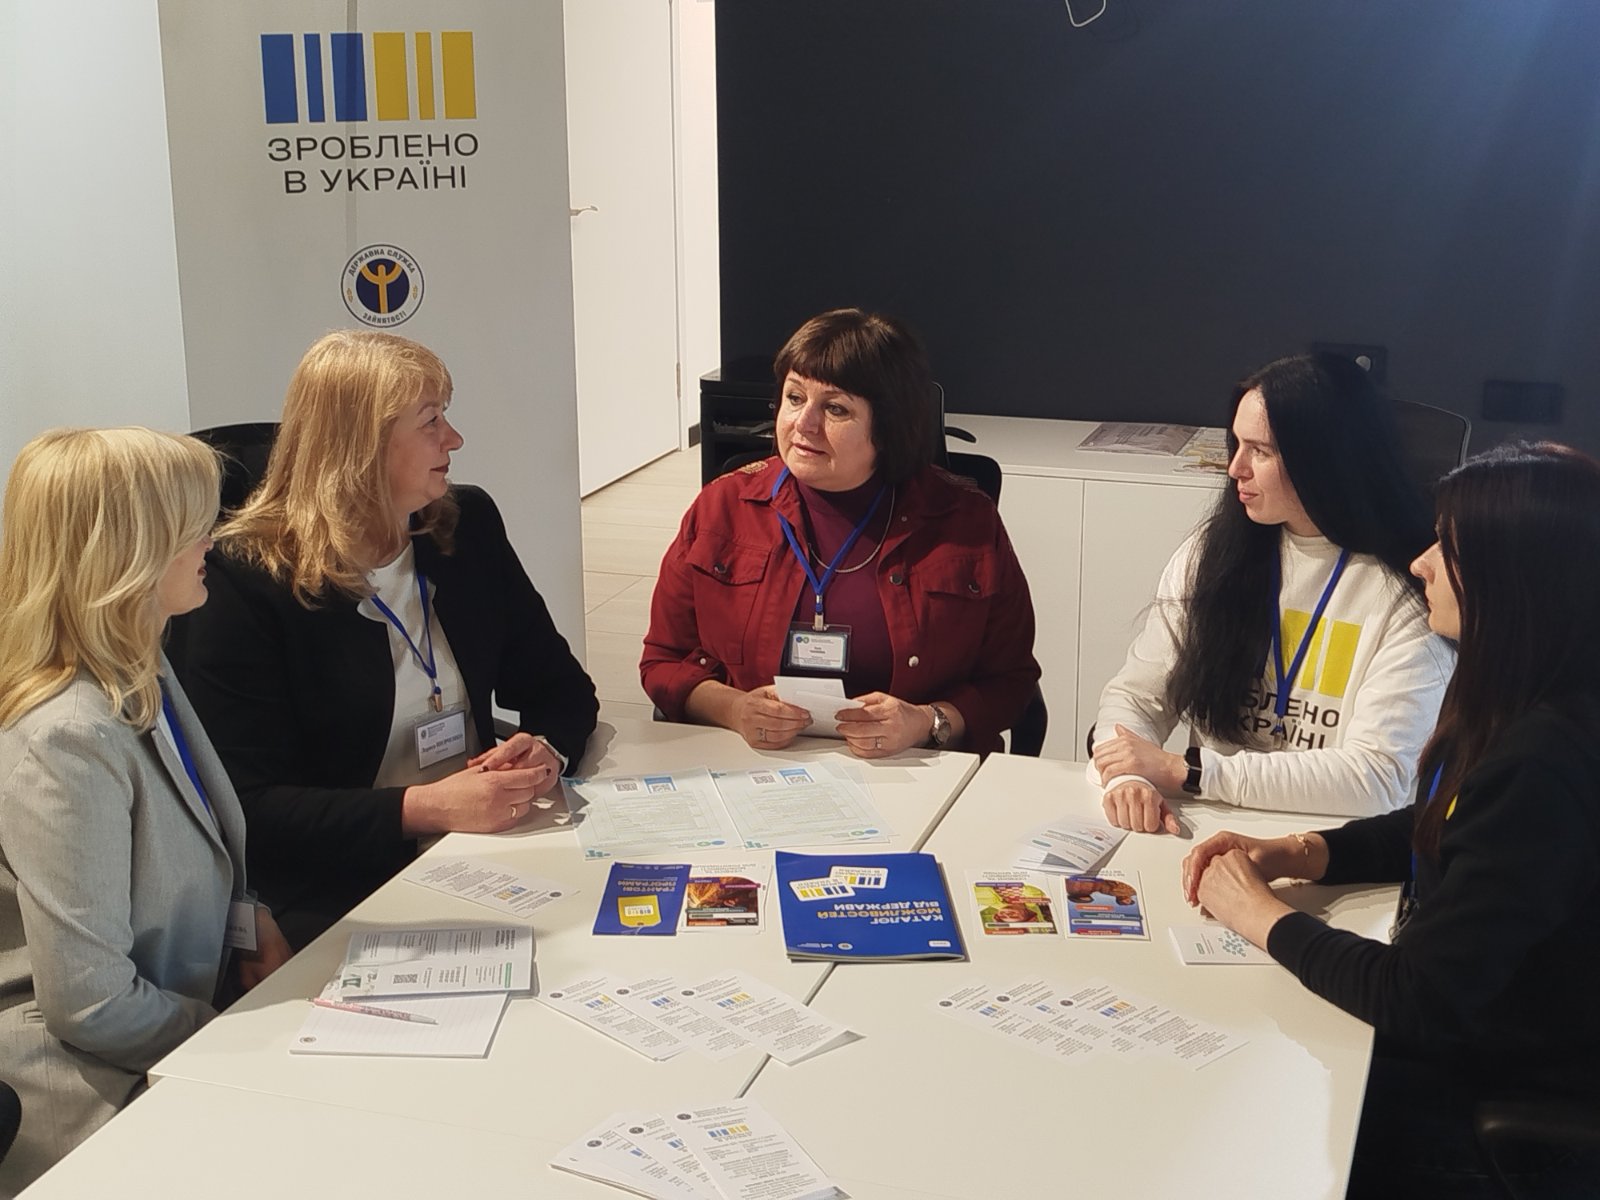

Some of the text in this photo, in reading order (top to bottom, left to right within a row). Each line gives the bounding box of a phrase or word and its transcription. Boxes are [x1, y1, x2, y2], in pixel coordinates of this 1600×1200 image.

[267, 133, 479, 162] ЗРОБЛЕНО
[285, 160, 467, 194] В УКРАЇНІ
[348, 248, 416, 276] ДЕРЖАВНА СЛУЖБА
[816, 907, 942, 920] МОЖЛИВОСТЕЙ
[833, 900, 939, 911] ВІД ДЕРЖАВИ
[869, 914, 944, 925] КАТАЛОГ
